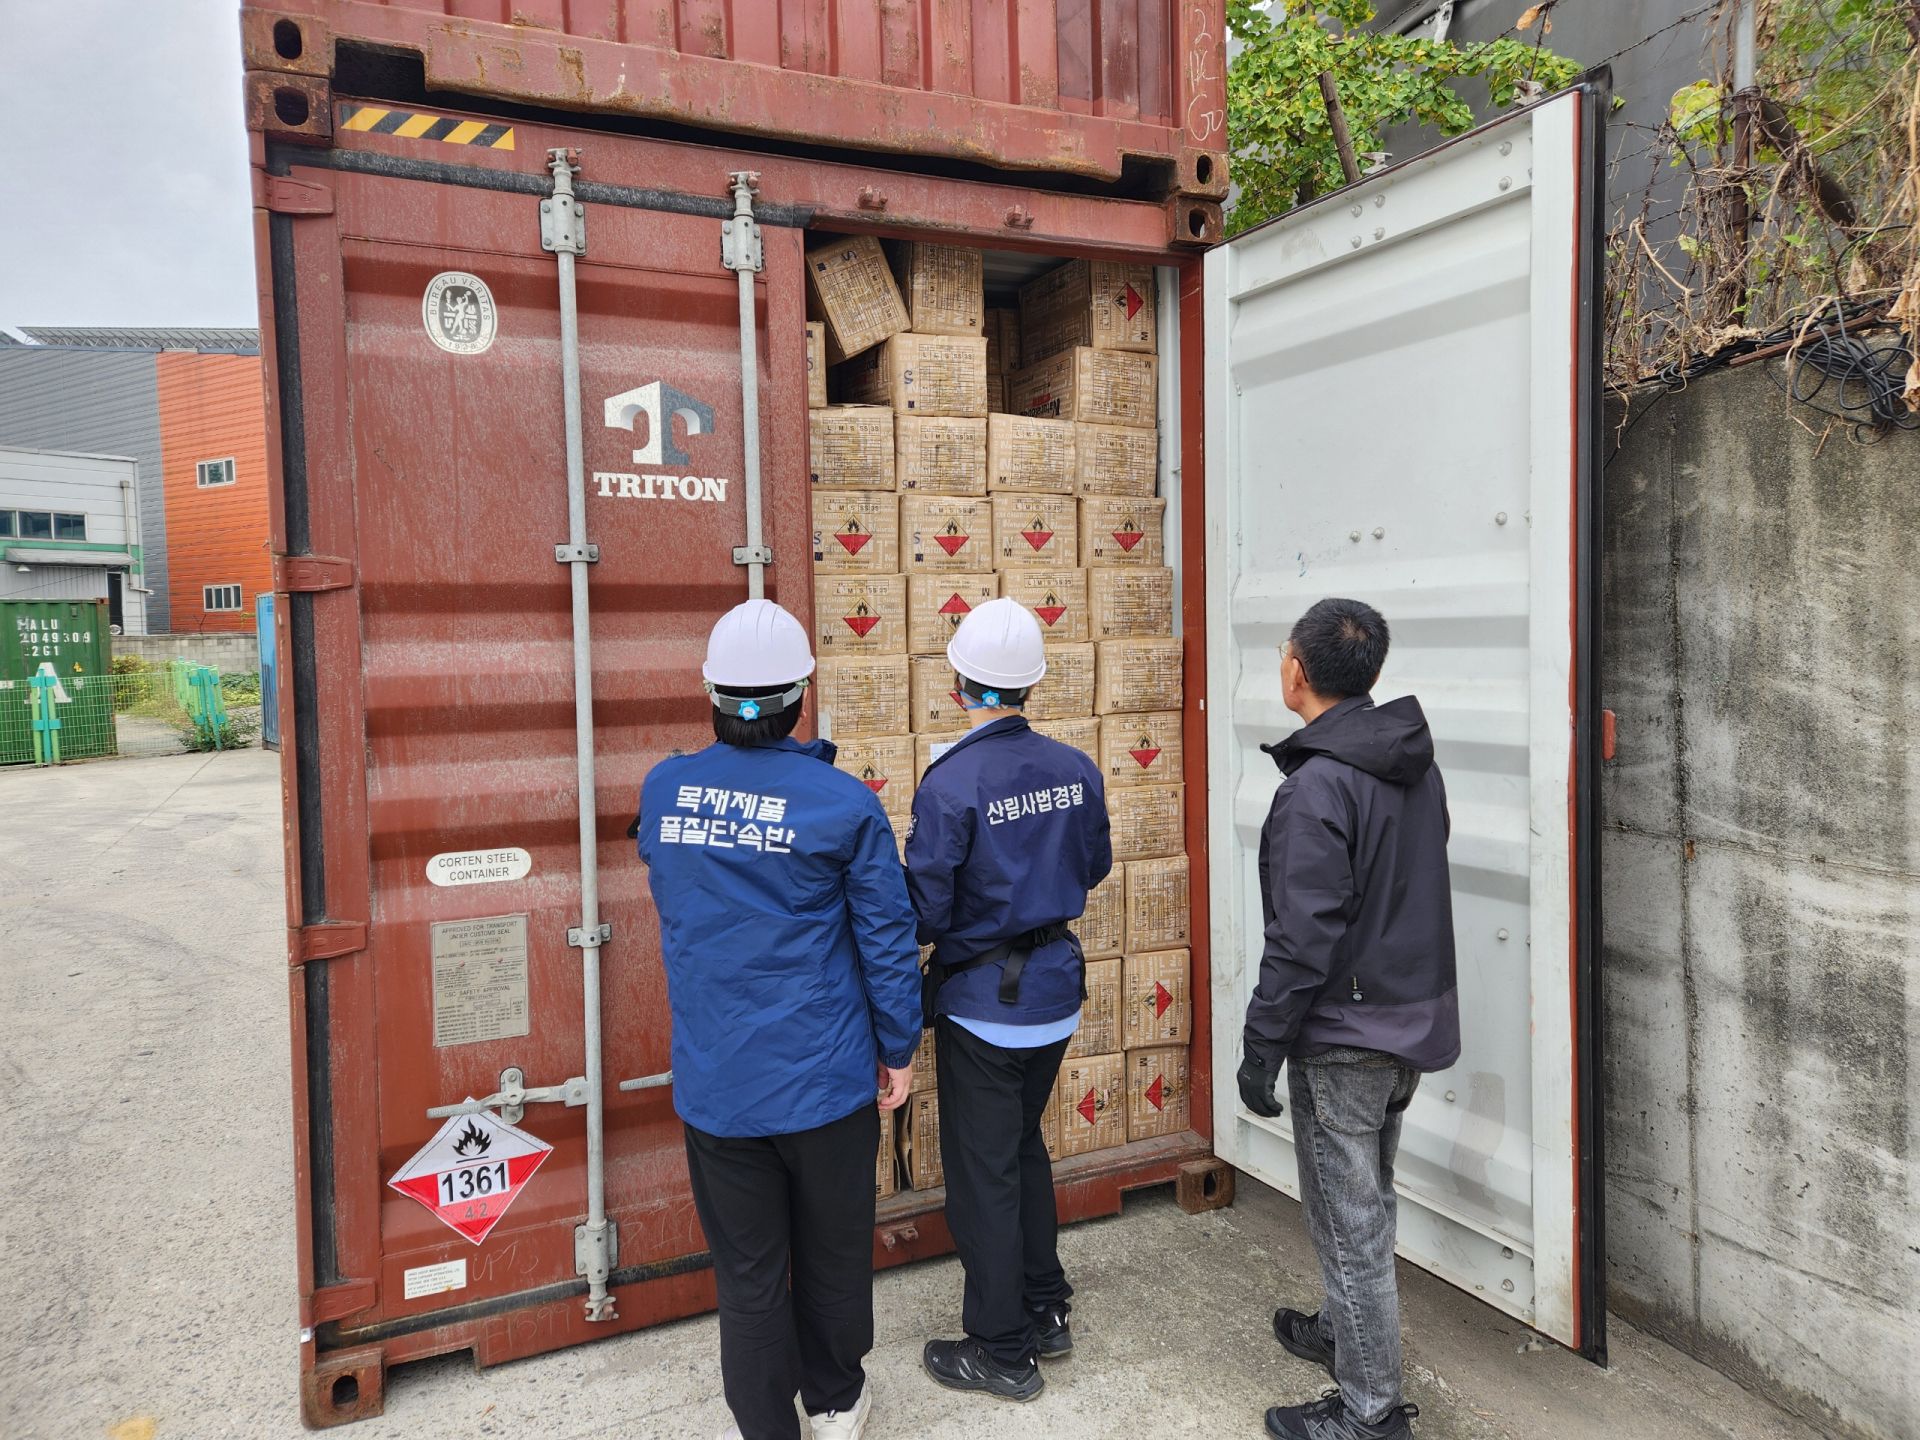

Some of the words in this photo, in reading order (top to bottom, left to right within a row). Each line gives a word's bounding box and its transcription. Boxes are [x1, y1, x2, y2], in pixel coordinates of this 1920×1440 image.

[430, 277, 456, 315] BUREAU
[462, 279, 490, 320] VERITAS
[1141, 332, 1148, 341] M
[593, 472, 728, 502] TRITON
[823, 636, 832, 644] M
[930, 710, 939, 719] M
[1112, 768, 1120, 776] M
[676, 785, 787, 823] 목재제품
[986, 783, 1084, 826] 산림사법경찰
[659, 816, 796, 854] 품질단속반
[438, 856, 481, 868] CORTEN
[487, 852, 519, 864] STEEL
[449, 867, 509, 881] CONTAINER
[442, 926, 471, 934] APPROVED
[486, 921, 517, 929] TRANSPORT
[1170, 1027, 1177, 1036] M
[1139, 1058, 1148, 1067] M
[1071, 1070, 1079, 1080] M
[921, 1100, 928, 1110] M
[442, 1162, 506, 1202] 1361
